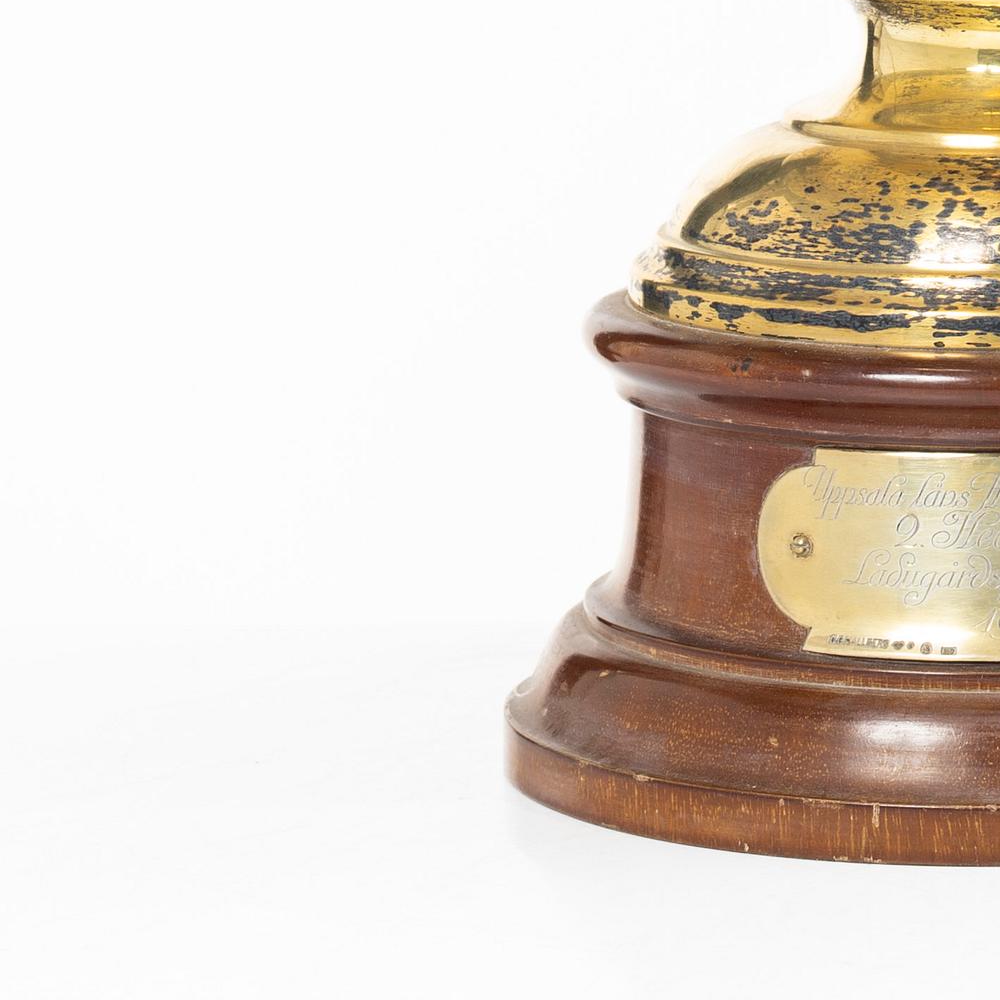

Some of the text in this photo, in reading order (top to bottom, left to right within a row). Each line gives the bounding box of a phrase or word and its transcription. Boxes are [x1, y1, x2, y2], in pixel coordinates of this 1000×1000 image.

[803, 464, 908, 520] Uppsala
[911, 472, 971, 508] läns
[894, 513, 925, 548] 2.
